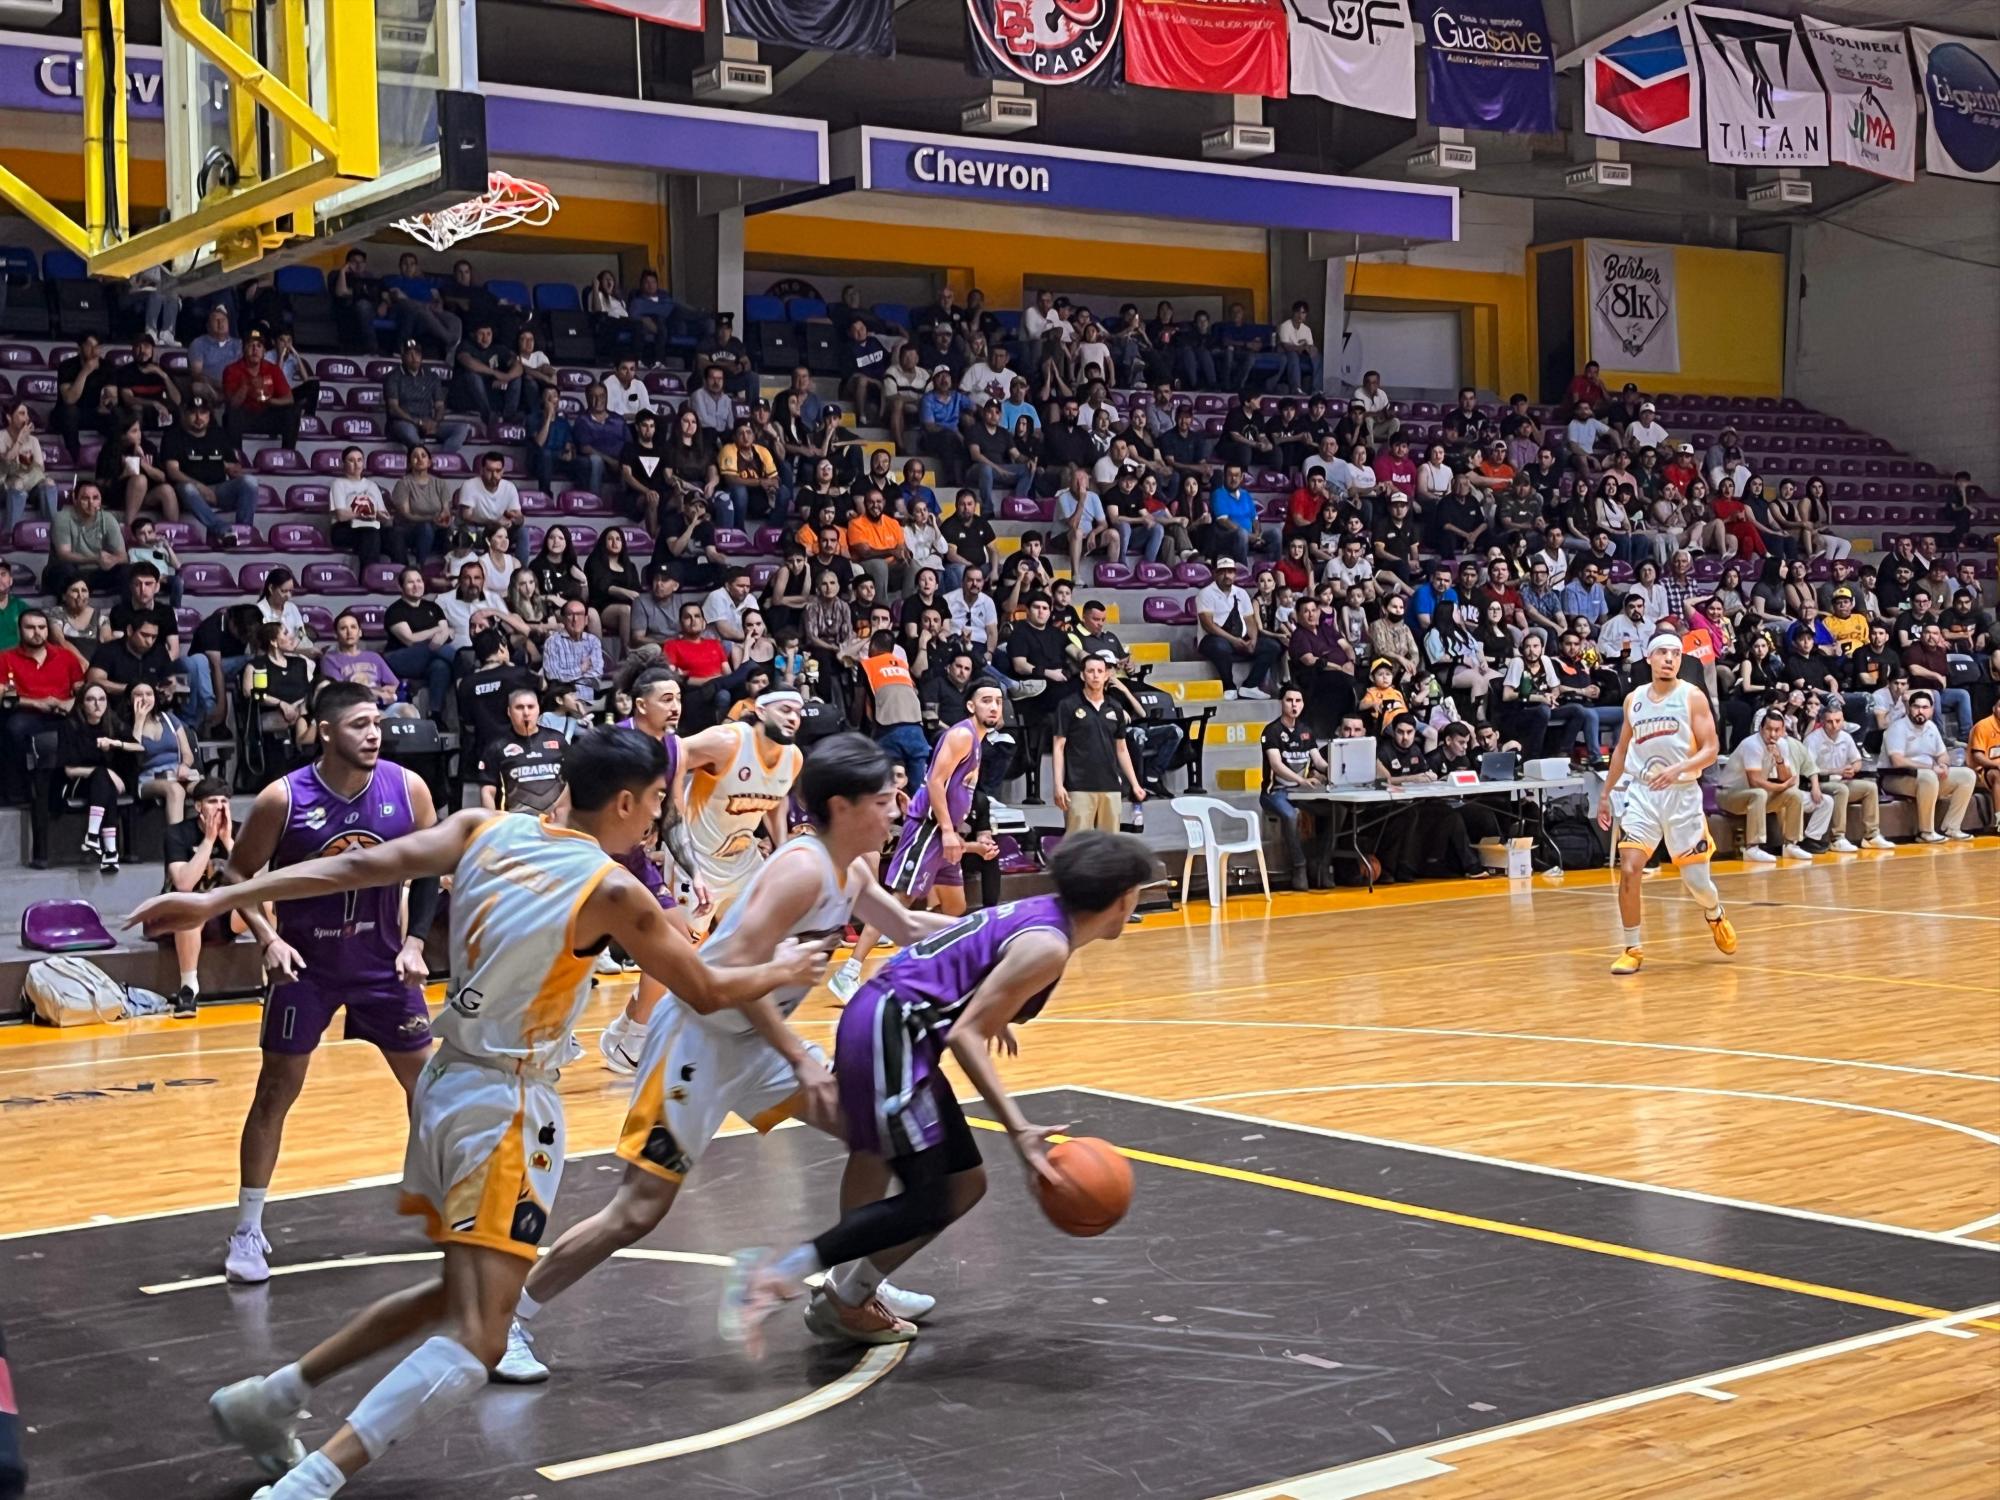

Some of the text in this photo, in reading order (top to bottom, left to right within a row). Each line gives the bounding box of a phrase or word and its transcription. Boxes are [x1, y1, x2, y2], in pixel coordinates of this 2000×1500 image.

[1034, 31, 1104, 73] PARK
[1719, 123, 1819, 152] TITAN
[1850, 107, 1896, 150] JIMA
[913, 146, 1050, 193] Chevron
[1603, 253, 1662, 286] Barber
[391, 724, 416, 735] R 12
